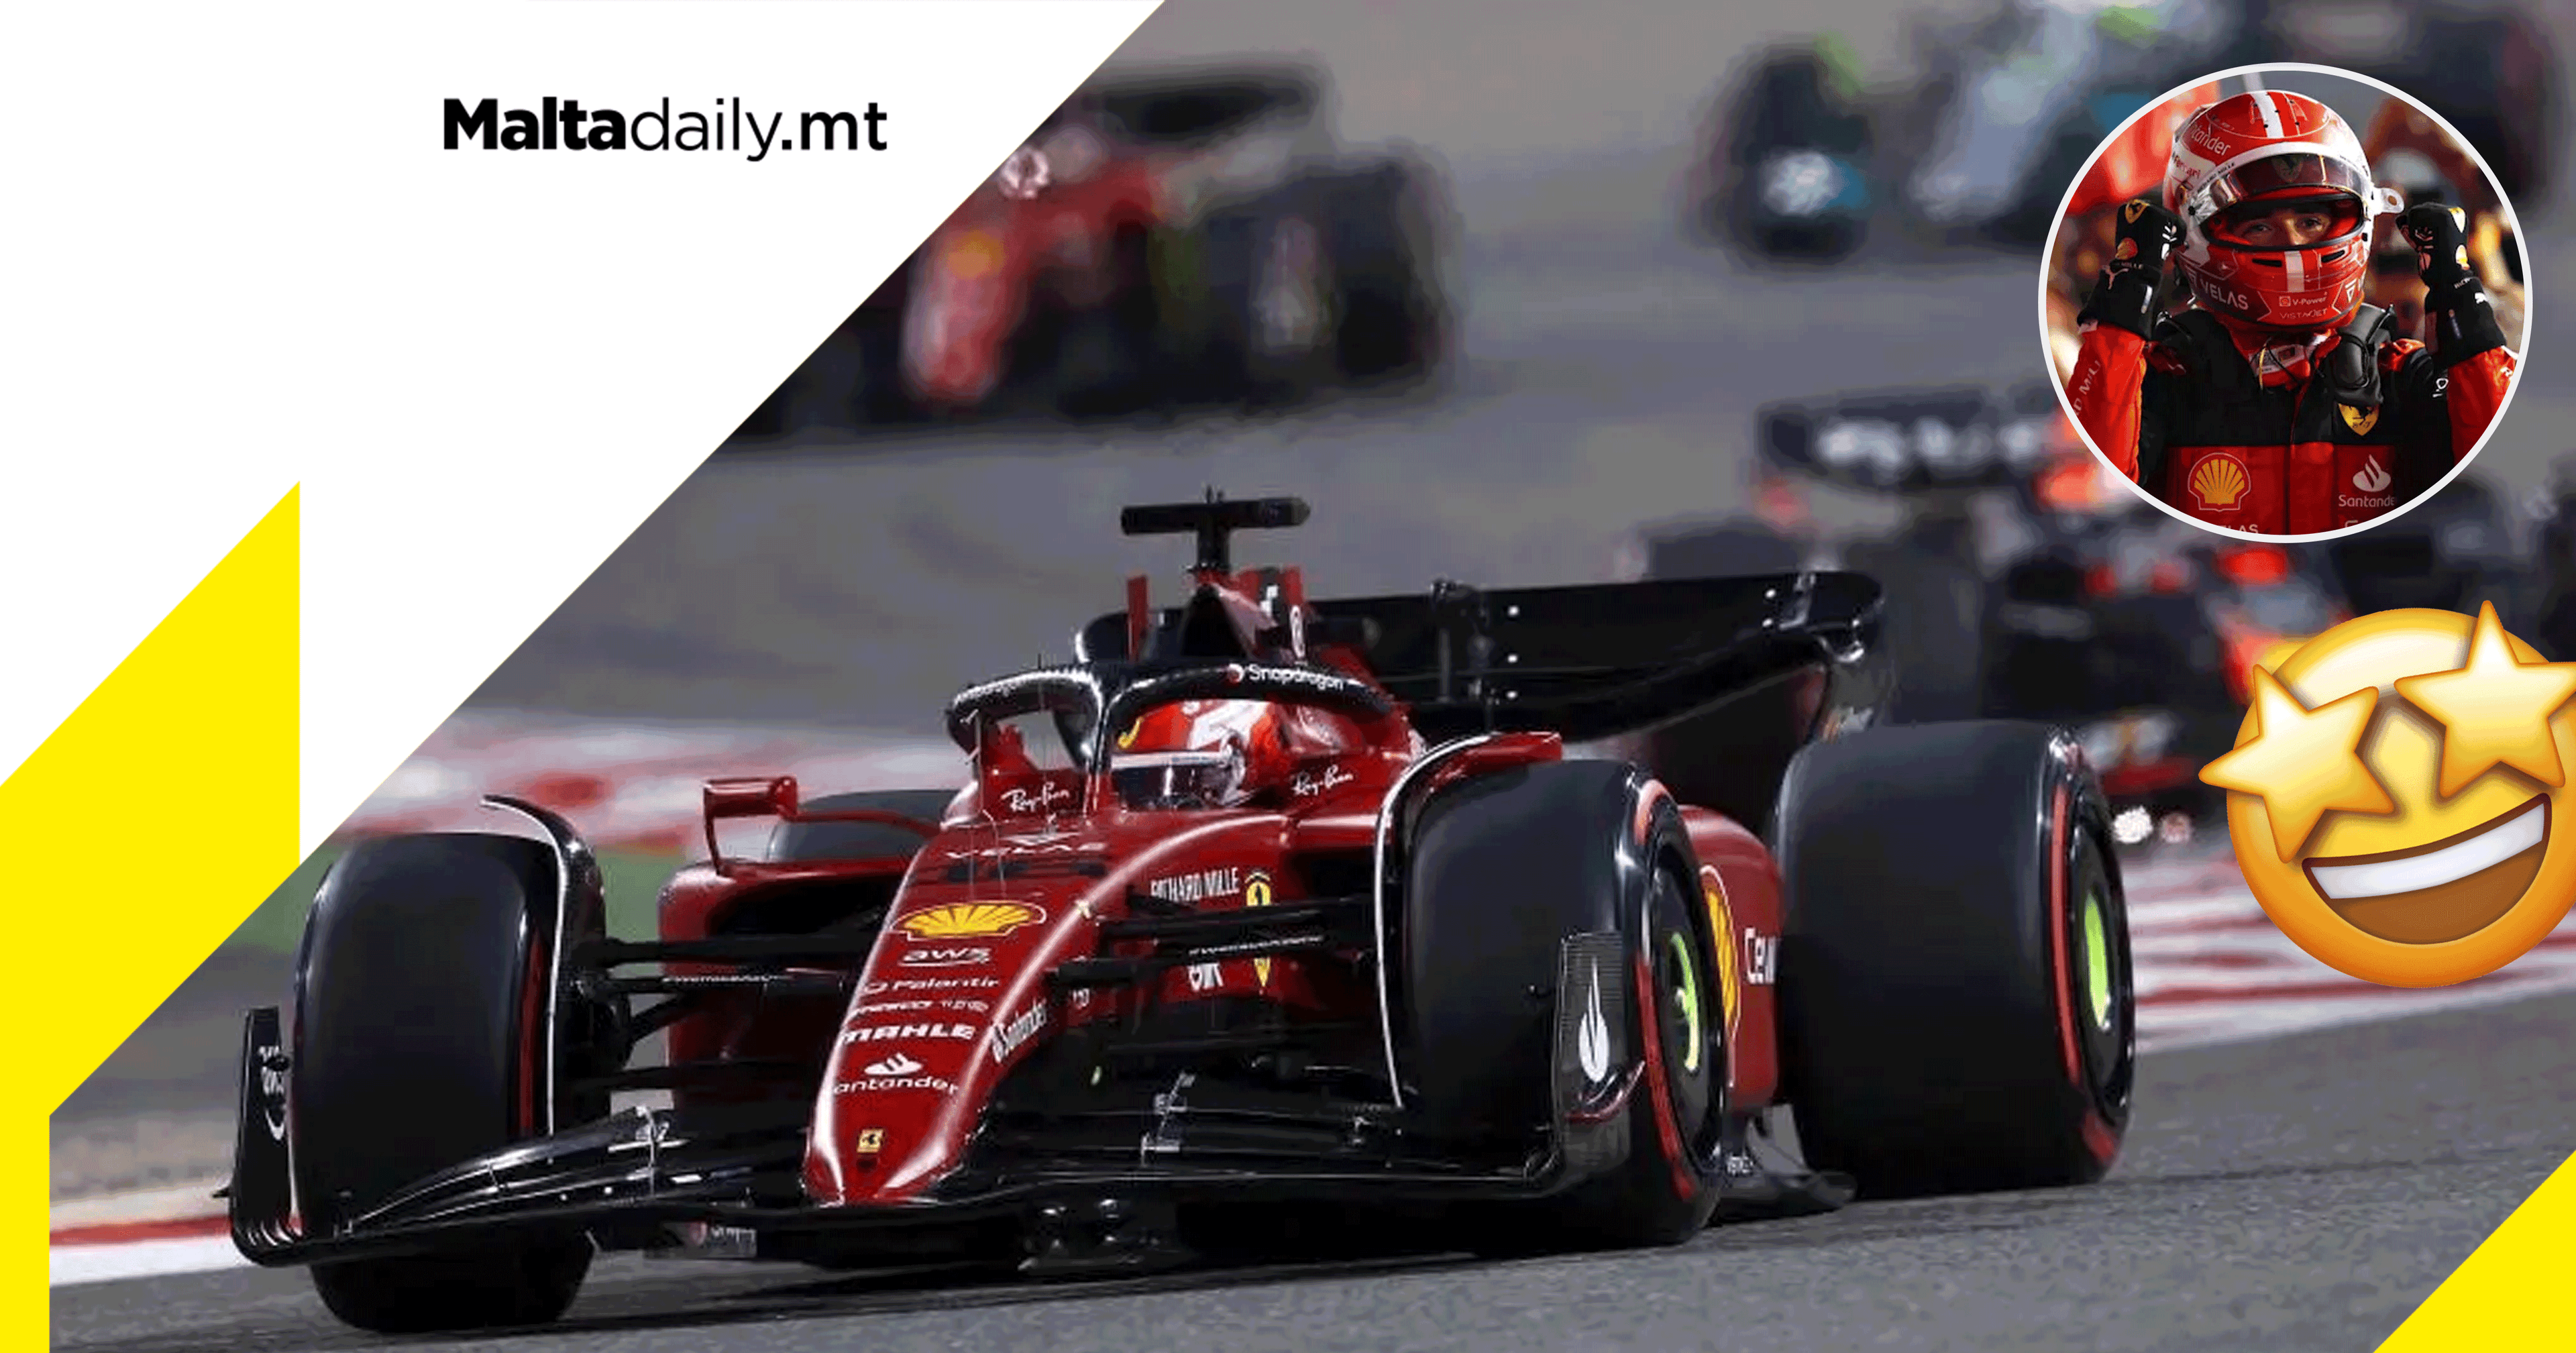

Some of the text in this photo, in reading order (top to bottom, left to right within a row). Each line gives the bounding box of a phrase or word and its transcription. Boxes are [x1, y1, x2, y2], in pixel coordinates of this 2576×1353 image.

[2200, 278, 2249, 311] VELAS
[1248, 663, 1344, 691] Snapdragon
[892, 976, 999, 991] Palantir
[843, 1023, 976, 1046] MAHLE
